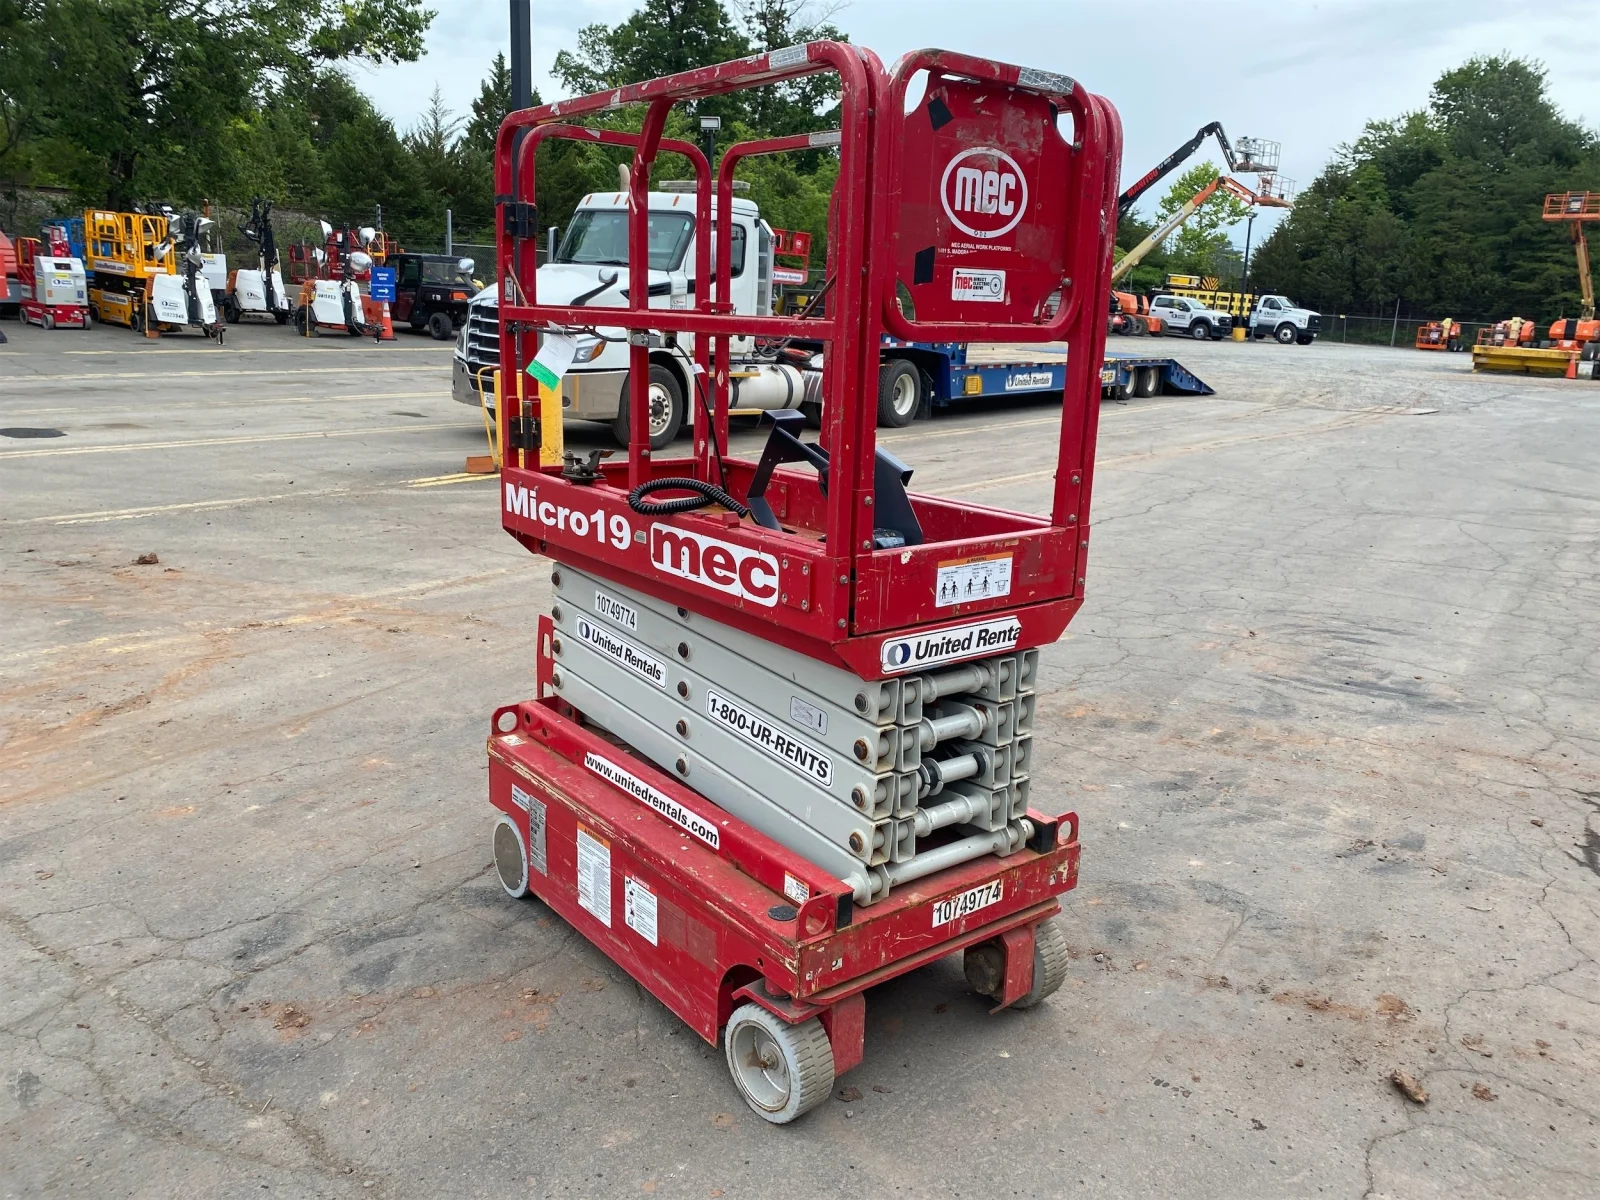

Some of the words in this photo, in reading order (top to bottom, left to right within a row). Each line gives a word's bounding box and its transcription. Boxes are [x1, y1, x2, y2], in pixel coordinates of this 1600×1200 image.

[1126, 168, 1159, 198] MANITOU
[1014, 375, 1031, 387] United
[1032, 375, 1050, 386] Rentals
[505, 482, 632, 550] Micro19
[652, 527, 778, 599] mec
[596, 593, 636, 629] 10749774
[591, 628, 623, 659] United
[624, 647, 662, 681] Rentals
[914, 631, 974, 661] United
[709, 697, 829, 779] 1-800-UR-RENTS
[585, 755, 718, 846] www.unitedrentals.com
[634, 875, 650, 891] DANGER
[934, 881, 1002, 924] 10749774
